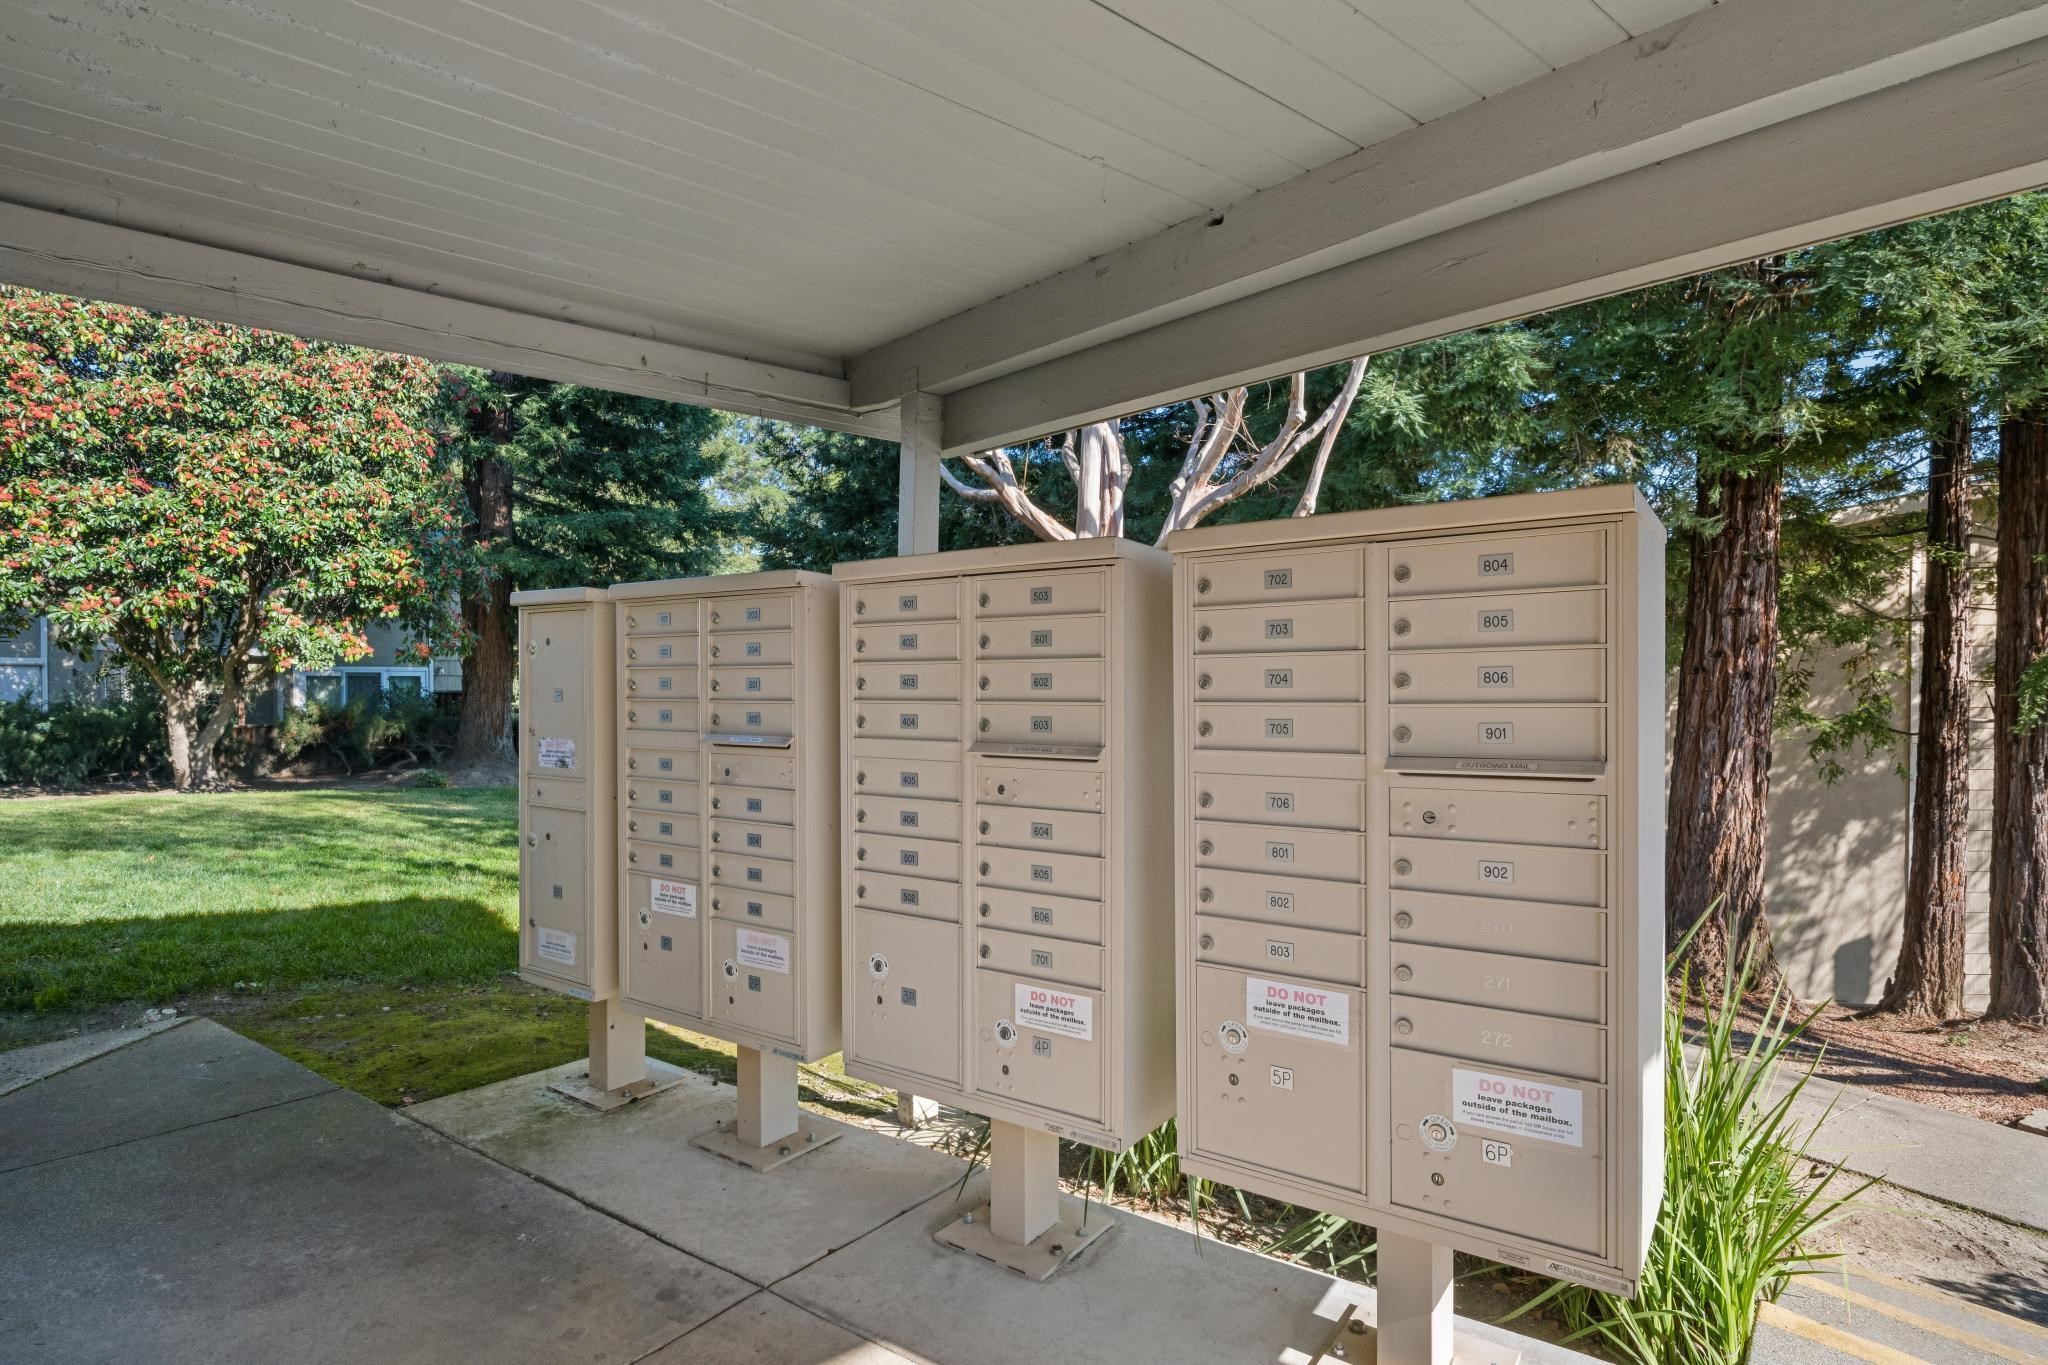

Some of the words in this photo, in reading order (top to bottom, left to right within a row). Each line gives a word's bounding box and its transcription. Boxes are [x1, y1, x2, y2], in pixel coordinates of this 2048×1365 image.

[1482, 558, 1509, 574] 804
[1268, 573, 1288, 586] 702
[1033, 591, 1049, 602] 503
[902, 599, 914, 609] 401
[1482, 614, 1509, 629] 805
[1269, 623, 1289, 636] 703
[902, 638, 915, 647] 402
[1034, 634, 1048, 644] 601
[902, 678, 915, 687] 403
[1033, 677, 1049, 687] 602
[1269, 673, 1289, 686] 704
[1482, 670, 1509, 685] 806
[902, 717, 915, 727] 404
[1033, 720, 1049, 730] 603
[1269, 723, 1290, 736] 705
[1484, 727, 1508, 740] 901
[902, 775, 916, 785] 405
[1269, 796, 1290, 809] 706
[902, 814, 916, 824] 406
[1033, 827, 1050, 837] 604
[903, 853, 915, 864] 501
[1270, 846, 1290, 859] 801
[1033, 869, 1050, 880] 605
[1483, 865, 1509, 880] 902
[660, 883, 671, 893] DO
[671, 885, 686, 894] NOT
[902, 892, 916, 903] 502
[1269, 895, 1291, 909] 802
[1034, 912, 1050, 923] 606
[1480, 919, 1513, 937] 270
[1269, 944, 1291, 959] 803
[1035, 954, 1049, 965] 701
[1483, 975, 1511, 992] 271
[903, 990, 915, 1004] 3P
[1030, 990, 1047, 1003] DO
[1050, 994, 1075, 1009] NOT
[1267, 985, 1289, 1000] DO
[1294, 990, 1327, 1007] NOT
[1029, 1002, 1045, 1011] leave
[1045, 1006, 1075, 1017] packages
[1266, 999, 1286, 1009] leave
[1287, 1003, 1325, 1016] packages
[1020, 1008, 1041, 1017] outside
[1049, 1013, 1060, 1021] the
[1060, 1016, 1087, 1026] mailbox.
[1253, 1005, 1281, 1015] outside
[1292, 1012, 1305, 1020] the
[1307, 1015, 1341, 1027] mailbox.
[1481, 1031, 1513, 1048] 272
[1034, 1040, 1049, 1054] 4P
[1272, 1069, 1291, 1086] 5P
[1478, 1078, 1506, 1095] DO
[1512, 1084, 1555, 1104] NOT
[1477, 1093, 1503, 1105] leave
[1505, 1099, 1553, 1114] packages
[1461, 1099, 1497, 1113] outside
[1499, 1107, 1509, 1115] of
[1511, 1109, 1528, 1119] the
[1530, 1113, 1573, 1127] mailbox.
[1485, 1143, 1508, 1162] 6P
